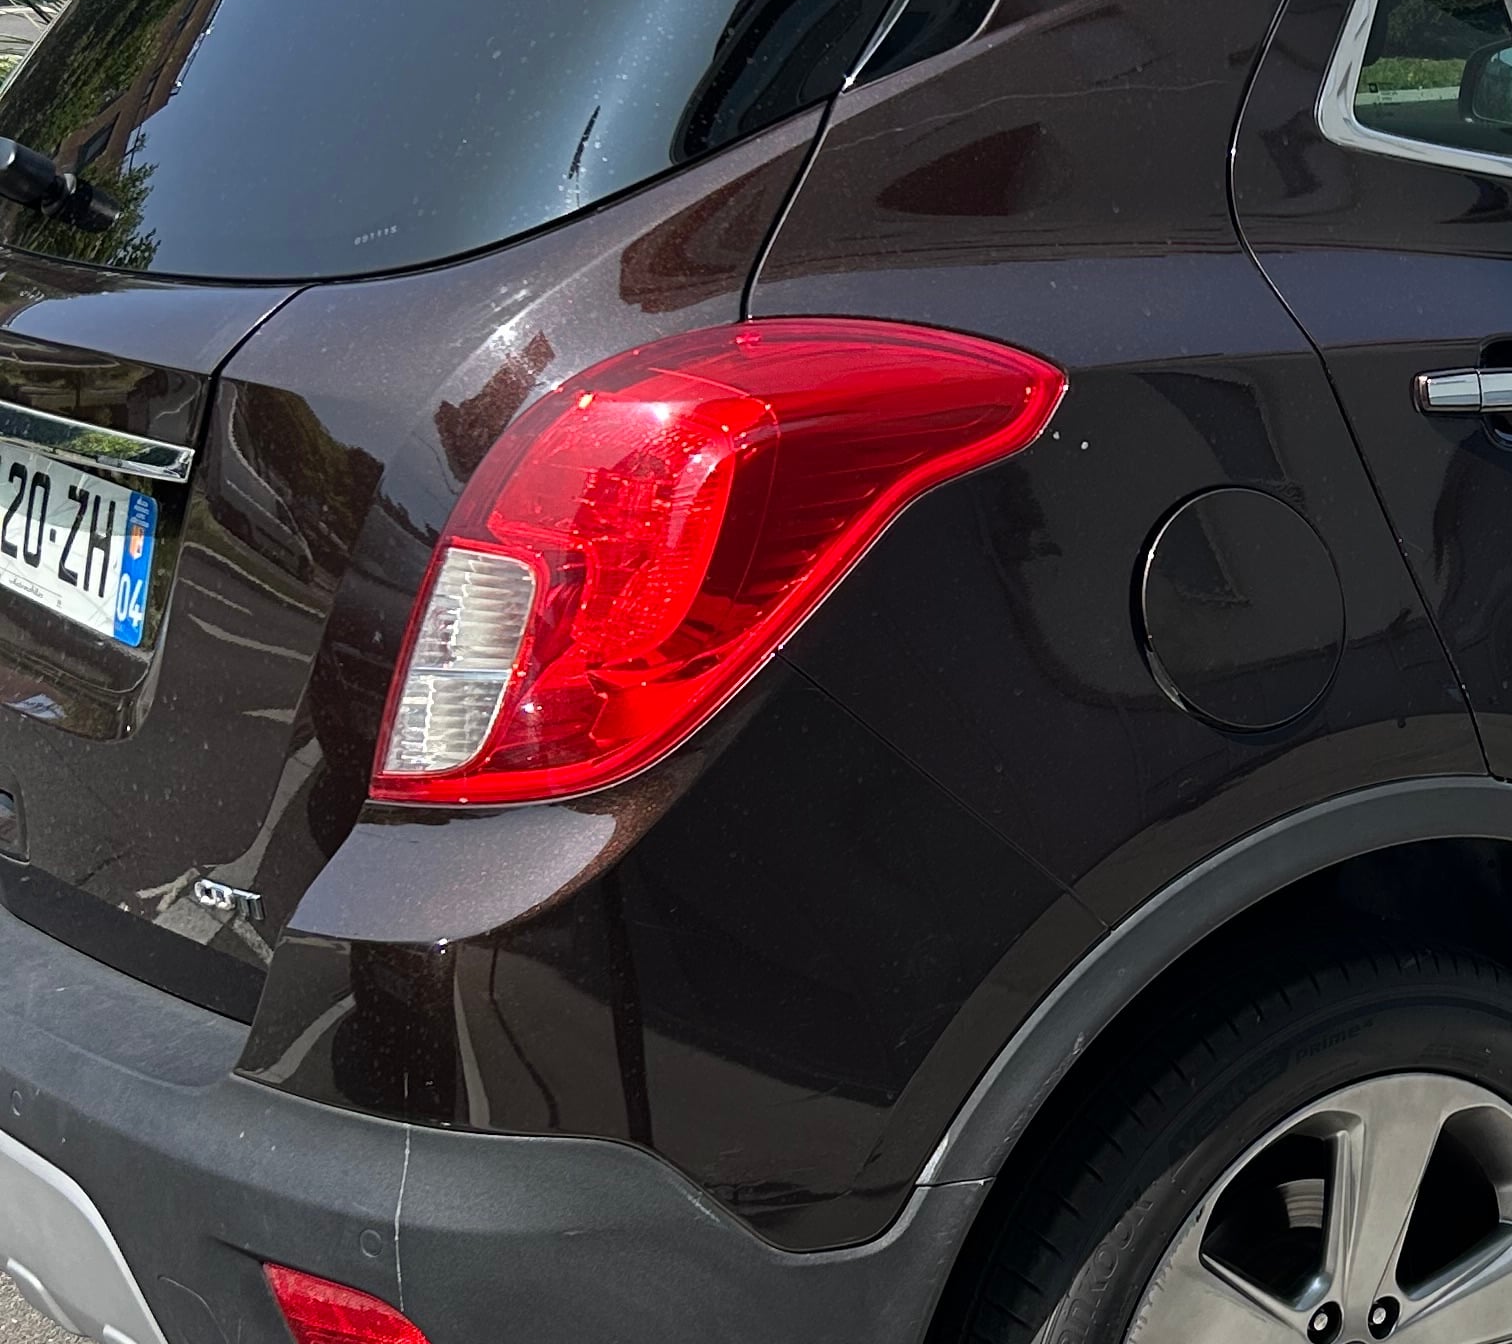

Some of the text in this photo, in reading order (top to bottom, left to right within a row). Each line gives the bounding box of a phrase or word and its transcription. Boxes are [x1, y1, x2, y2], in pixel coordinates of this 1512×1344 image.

[0, 462, 116, 598] 20-ZH
[117, 573, 143, 628] 04
[194, 879, 265, 921] CDTI
